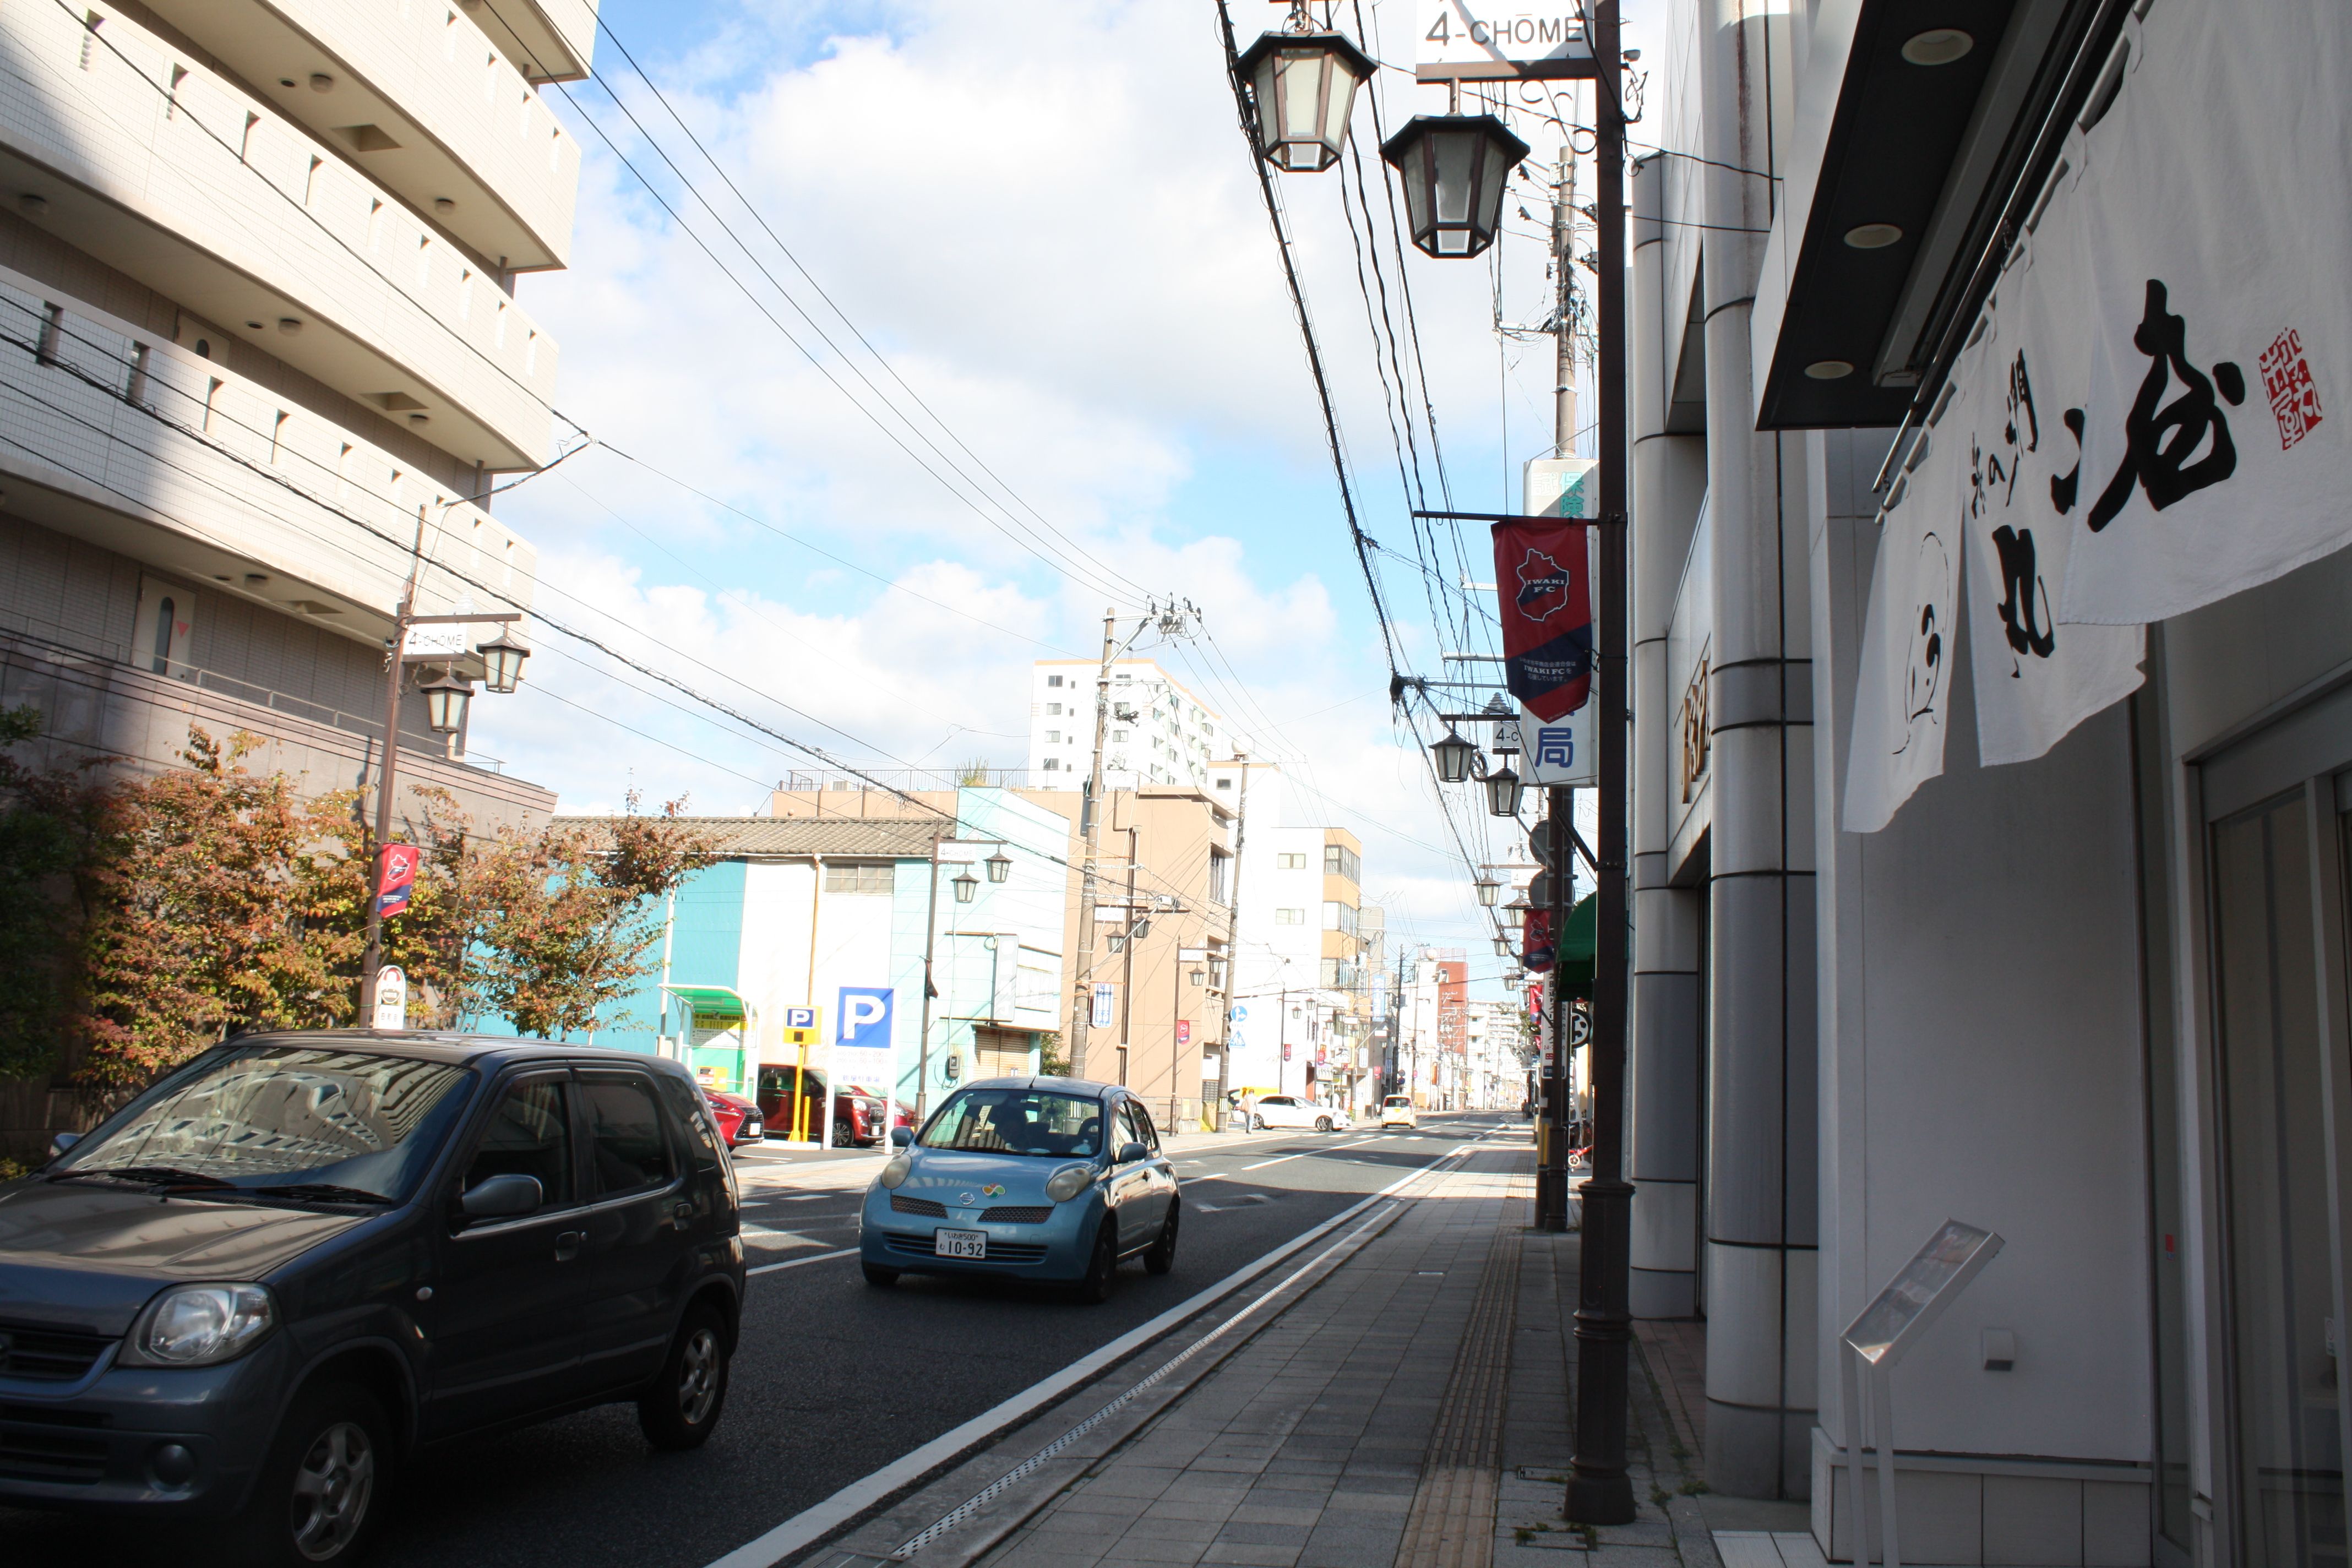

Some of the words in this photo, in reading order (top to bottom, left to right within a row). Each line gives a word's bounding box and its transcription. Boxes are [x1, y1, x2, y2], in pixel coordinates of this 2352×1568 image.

[1559, 471, 1585, 518] 保険
[1523, 665, 1550, 675] IWAKI
[791, 1010, 809, 1027] P
[843, 994, 886, 1039] P
[948, 1240, 983, 1256] 10-92
